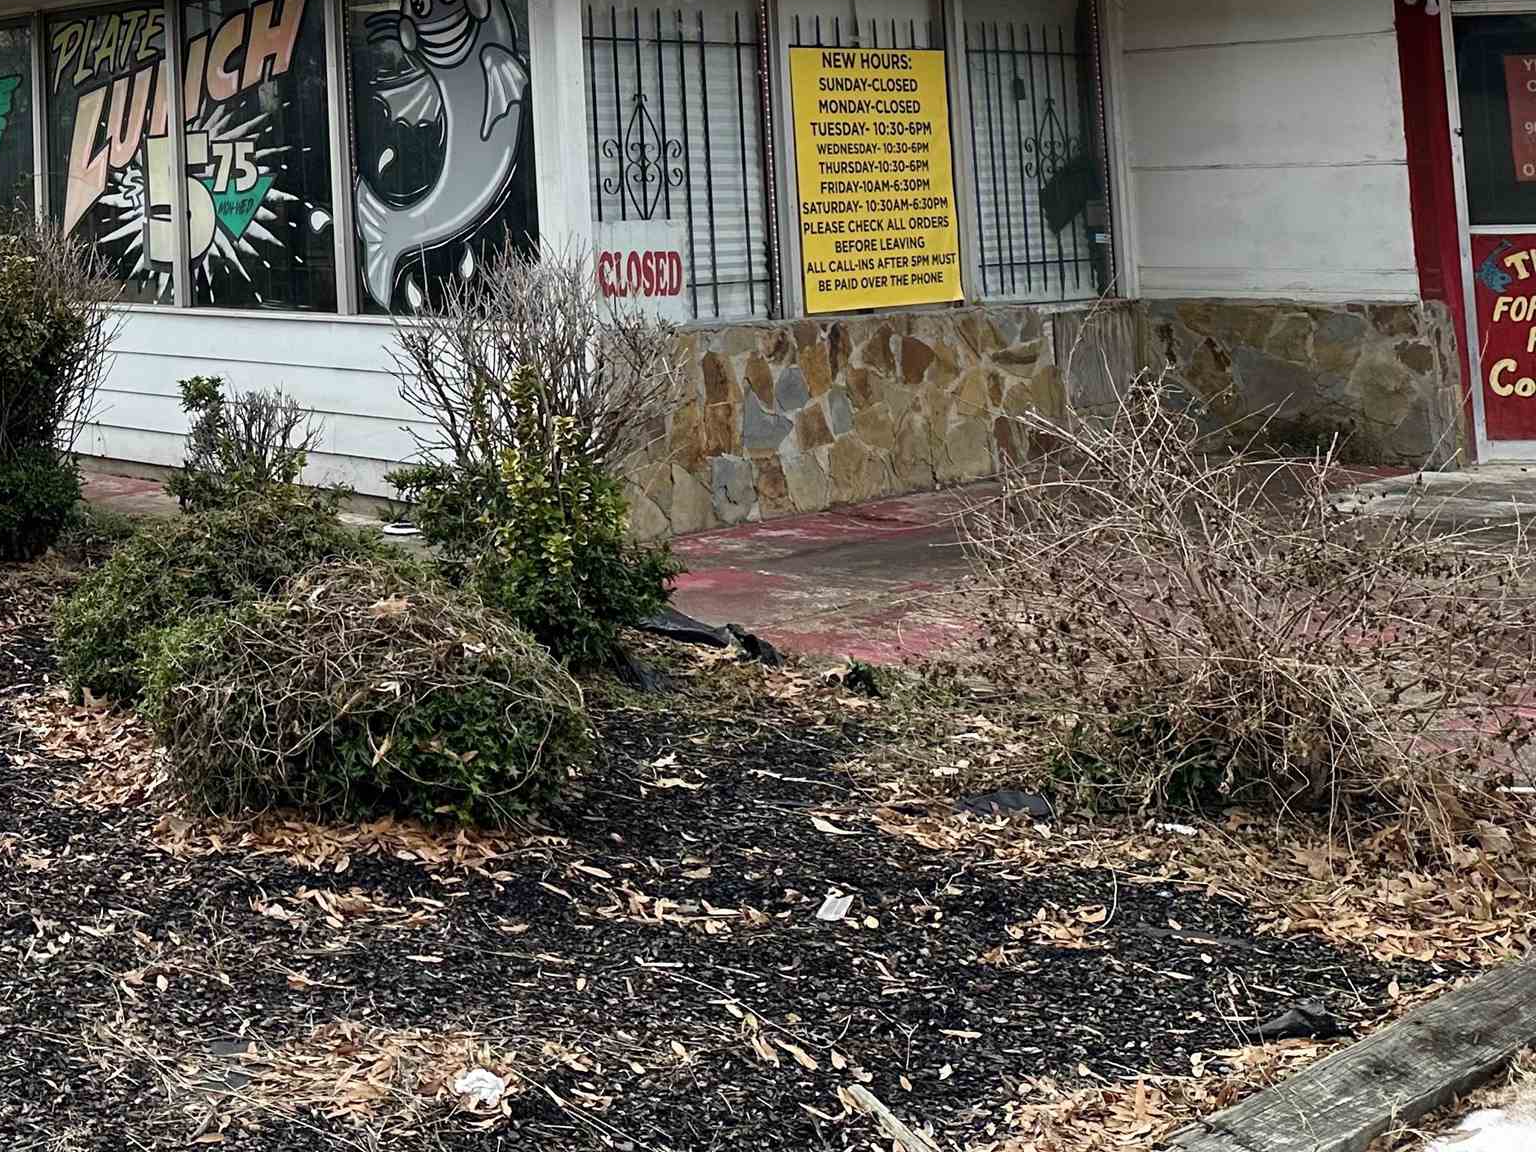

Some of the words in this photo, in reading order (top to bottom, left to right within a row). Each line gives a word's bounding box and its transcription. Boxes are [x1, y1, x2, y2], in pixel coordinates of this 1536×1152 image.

[52, 8, 165, 95] PLATE
[822, 52, 856, 68] NEW
[860, 53, 912, 70] HOURS:
[819, 77, 918, 92] SUNDAY-CLOSED
[819, 99, 920, 114] MONDAY-CLOSED
[810, 122, 869, 136] TUESDAY-
[873, 121, 932, 135] 10:30-6PM
[819, 160, 930, 174] THURSDAY-10:30-6PM
[820, 179, 930, 194] FRIDAY-10AM-6:30PM
[802, 200, 863, 214] SATURDAY-
[866, 197, 948, 212] 10:30AM-6:30PM
[803, 221, 845, 235] PLEASE
[848, 219, 884, 233] CHECK
[887, 217, 906, 231] ALL
[909, 216, 949, 230] ORDERS
[835, 239, 878, 253] BEFORE
[880, 237, 925, 251] LEAVING
[807, 260, 826, 274] ALL
[828, 258, 875, 273] CALL-INS
[877, 256, 909, 270] AFTER
[911, 254, 930, 268] 5PM
[931, 253, 957, 266] MUST
[598, 250, 682, 298] CLOSED
[818, 280, 832, 292] BE
[834, 277, 858, 291] PAID
[860, 276, 888, 289] OVER
[890, 274, 909, 287] THE
[910, 271, 944, 285] PHONE
